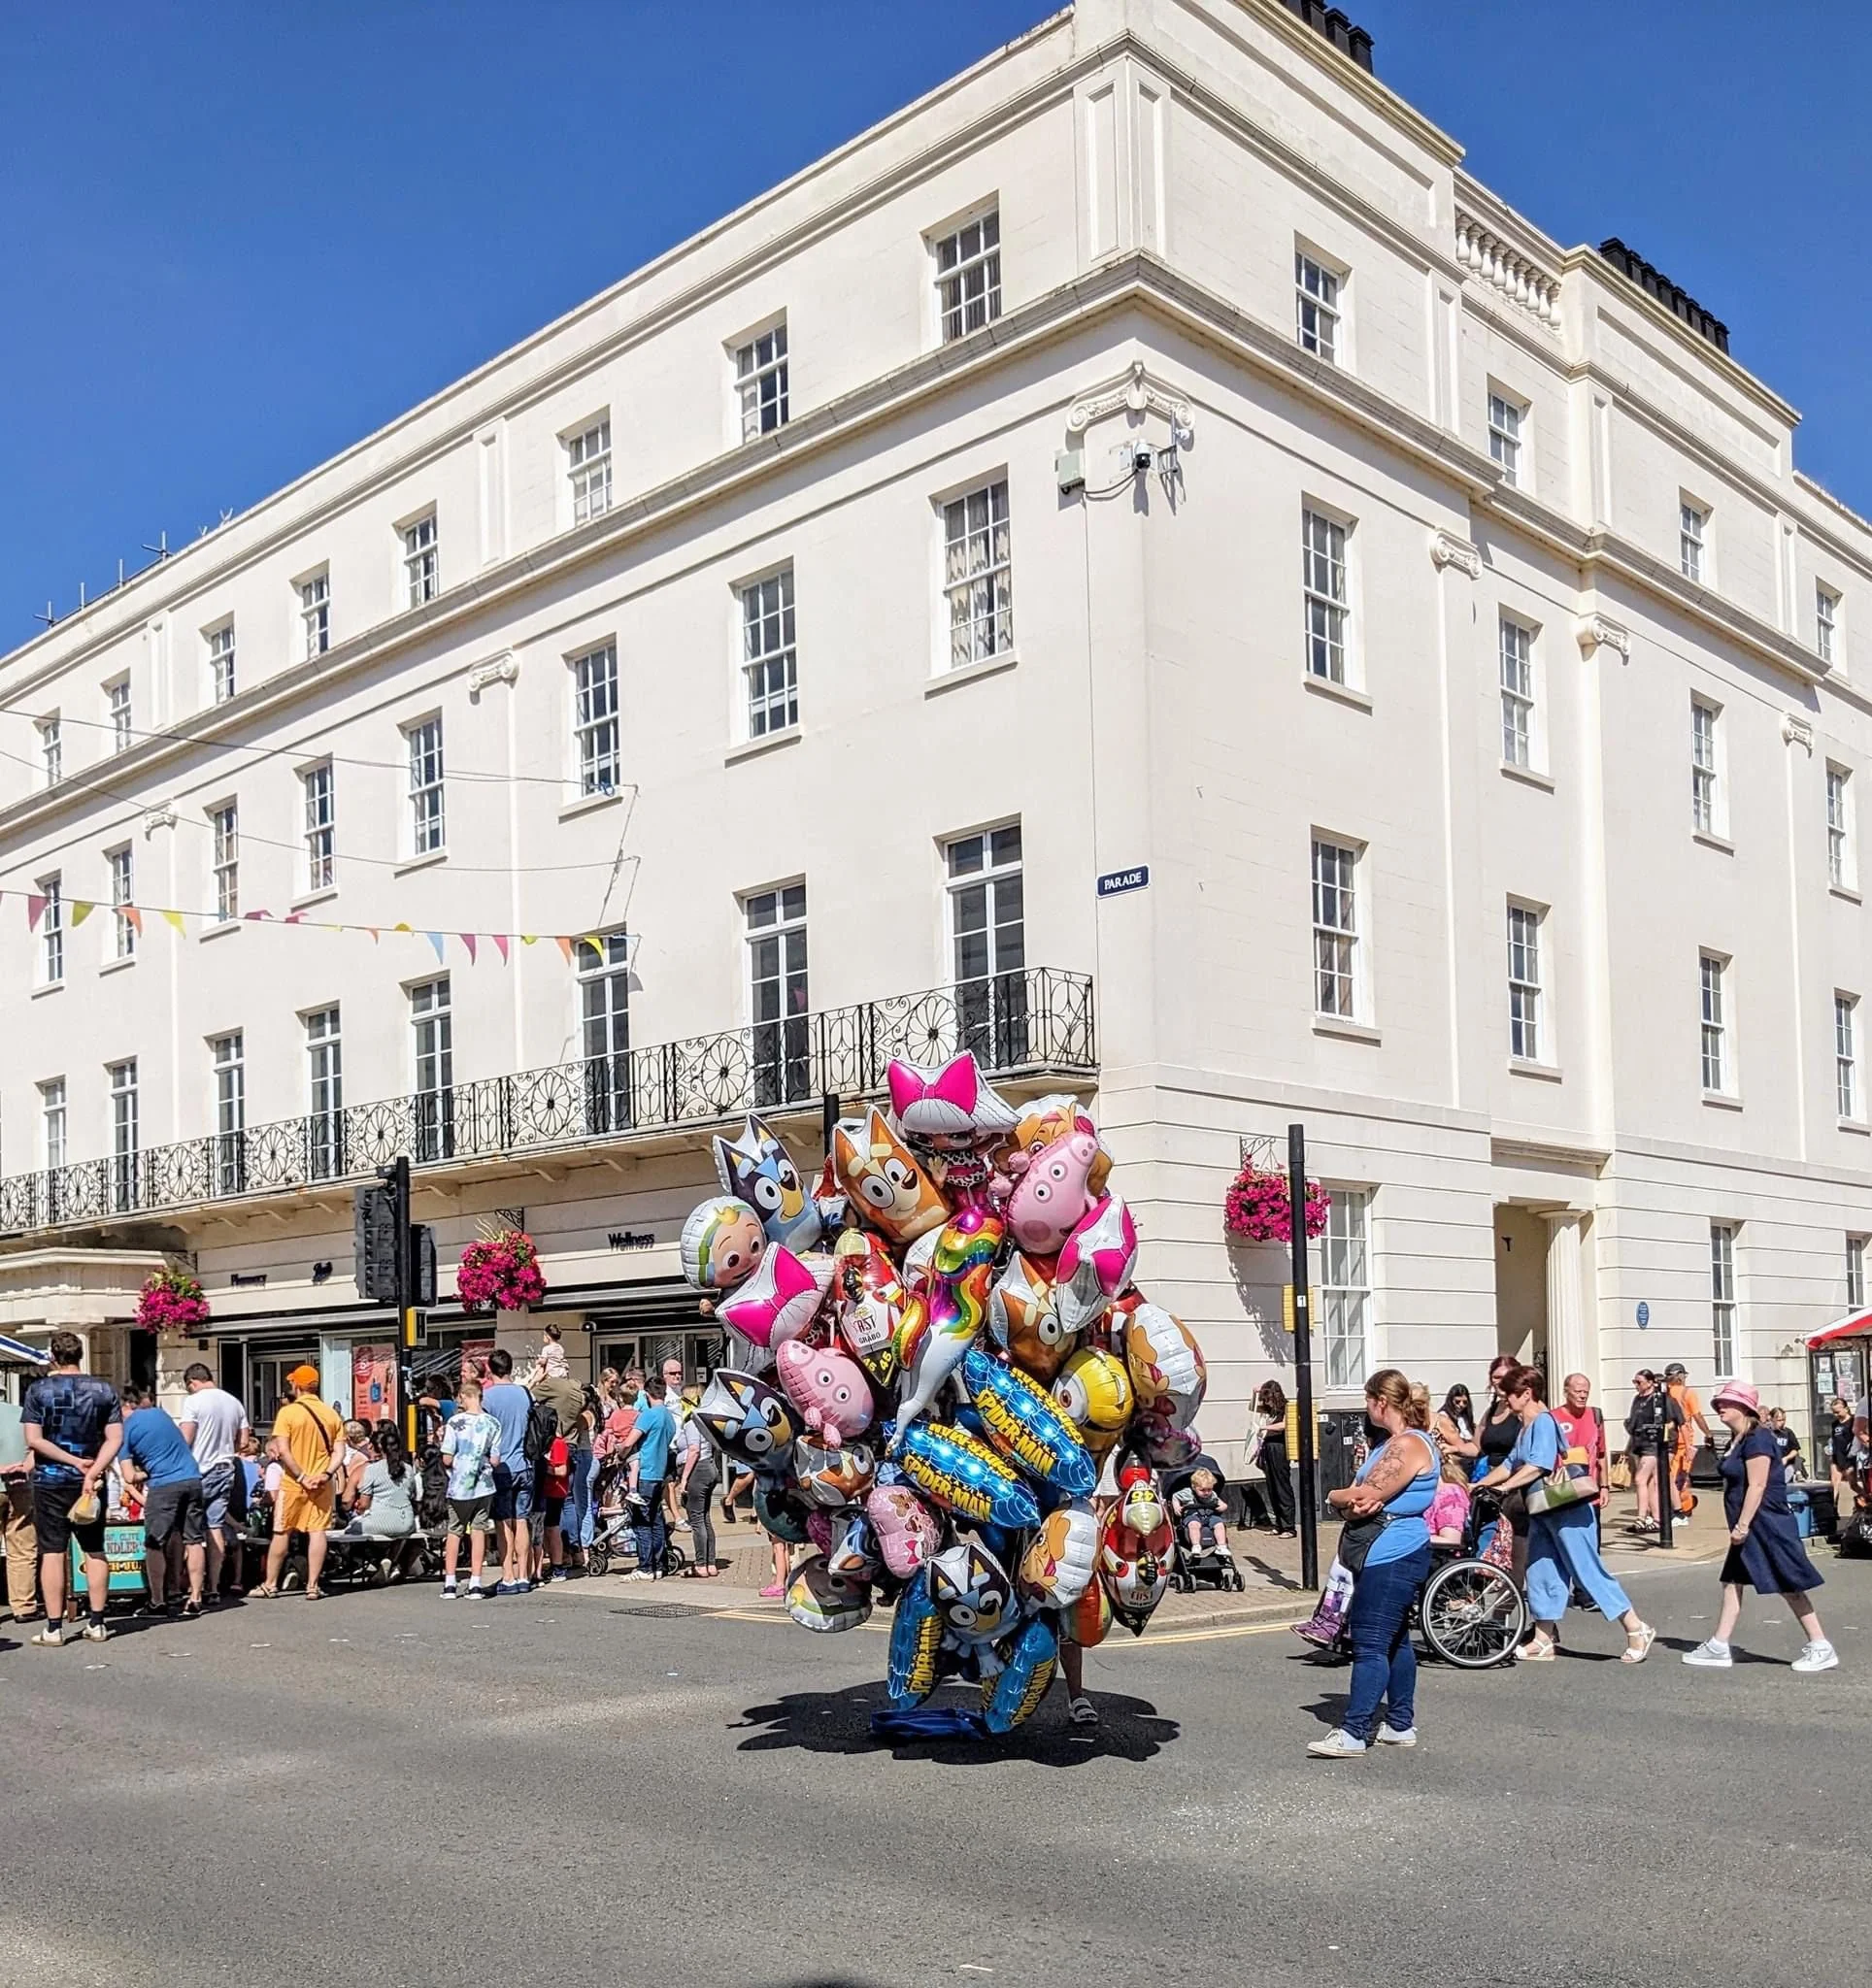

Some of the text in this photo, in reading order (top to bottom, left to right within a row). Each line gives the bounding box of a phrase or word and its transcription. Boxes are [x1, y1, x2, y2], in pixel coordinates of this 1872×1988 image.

[1104, 871, 1142, 890] PARADE
[607, 1231, 655, 1249] Wellness
[971, 1388, 1055, 1476] SPIDER-MAN
[901, 1454, 990, 1522] SPIDER-MAN
